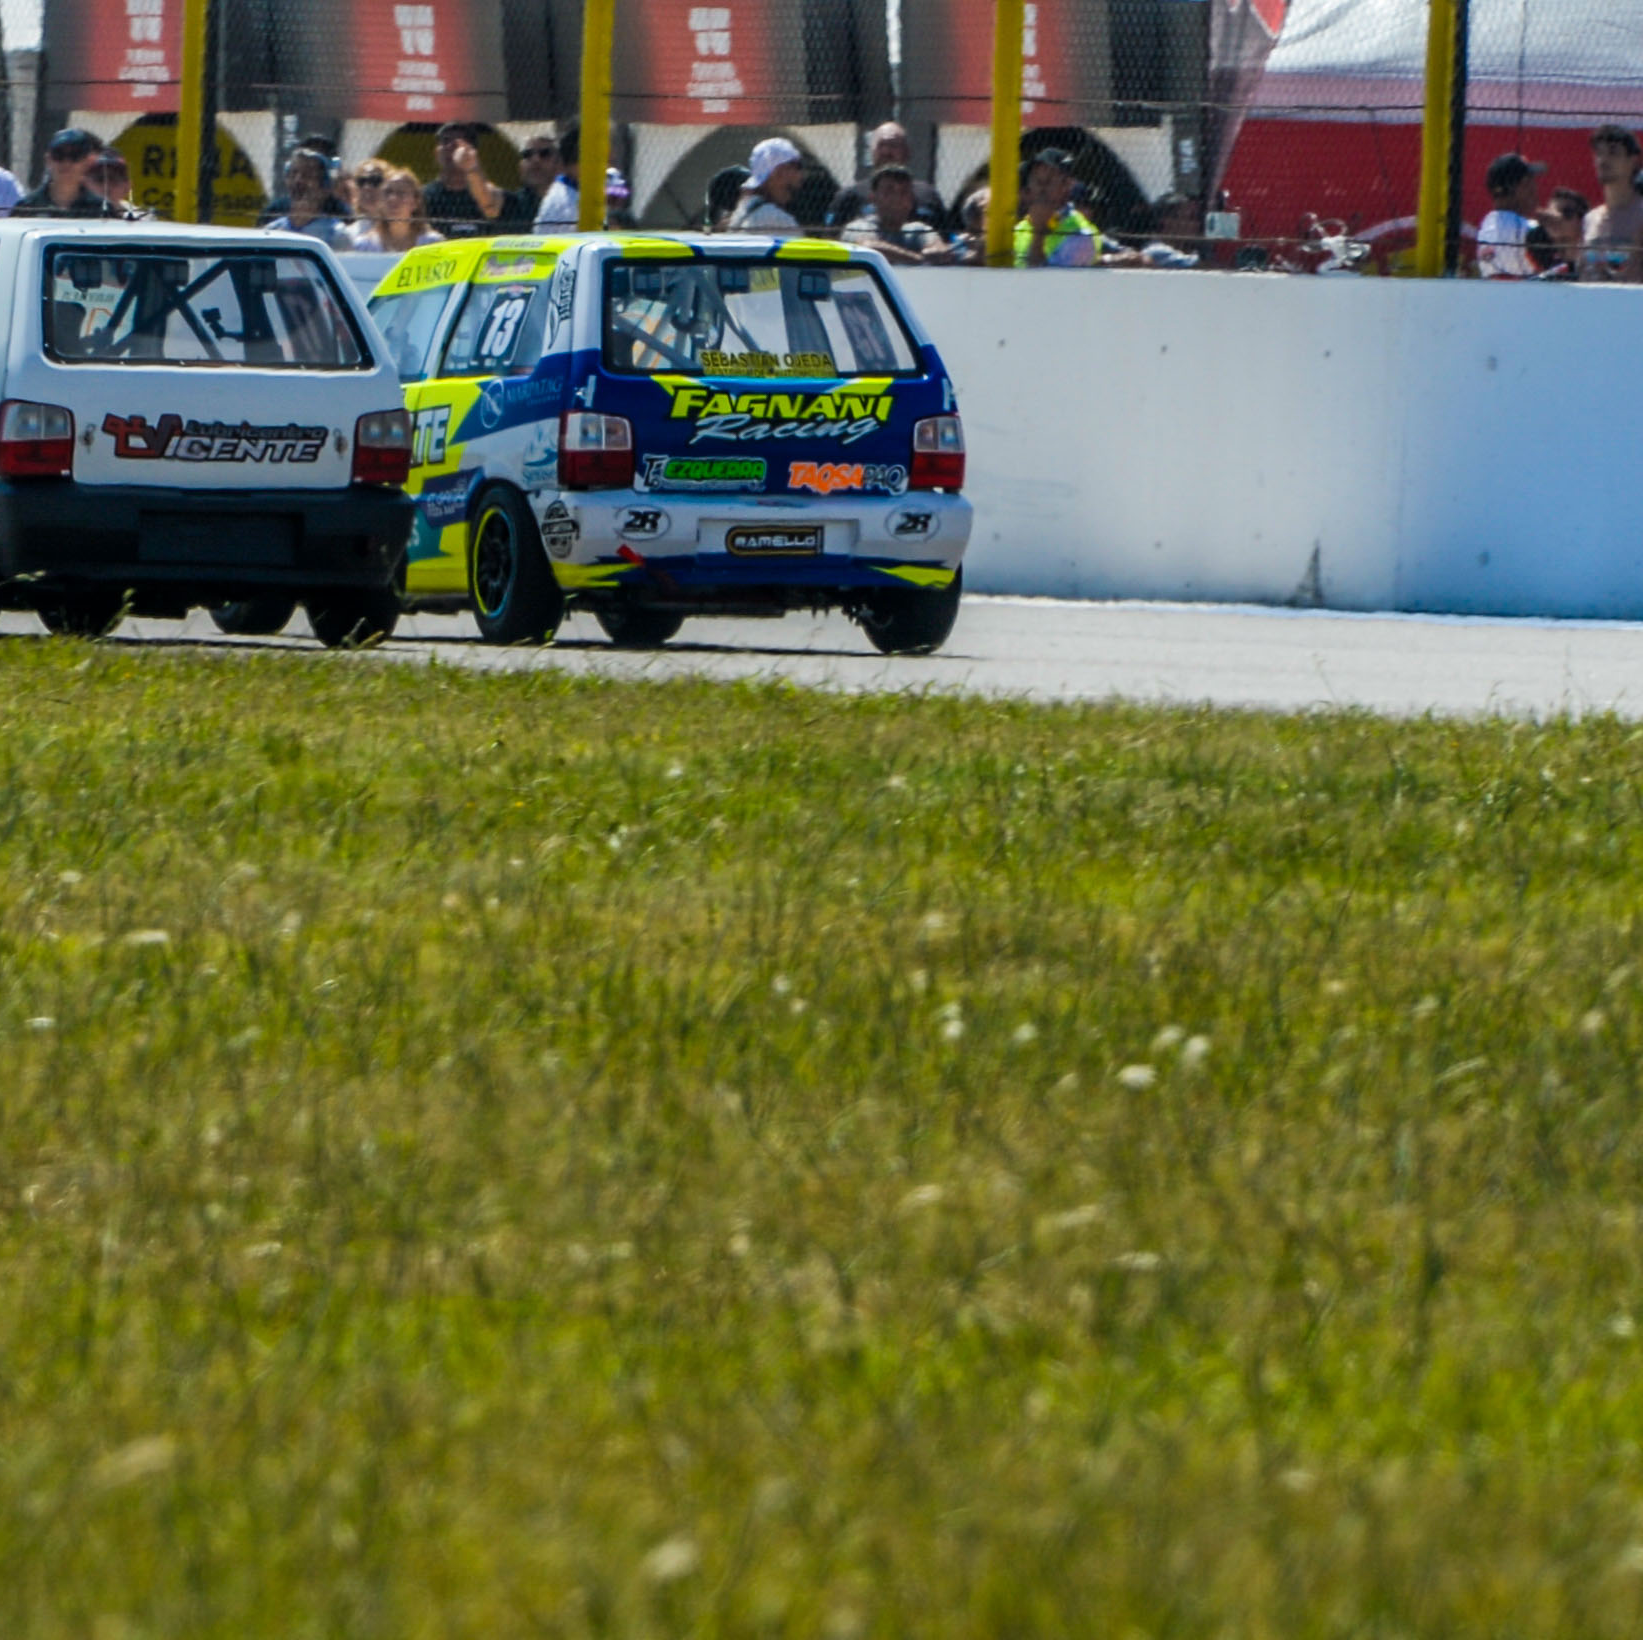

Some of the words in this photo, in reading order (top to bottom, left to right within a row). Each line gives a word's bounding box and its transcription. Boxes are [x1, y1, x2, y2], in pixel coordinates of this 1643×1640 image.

[480, 298, 526, 358] 13
[783, 352, 832, 368] OJEDA
[670, 386, 894, 422] FAGNANI
[688, 414, 882, 445] Racing
[733, 534, 818, 549] RAMELLO
